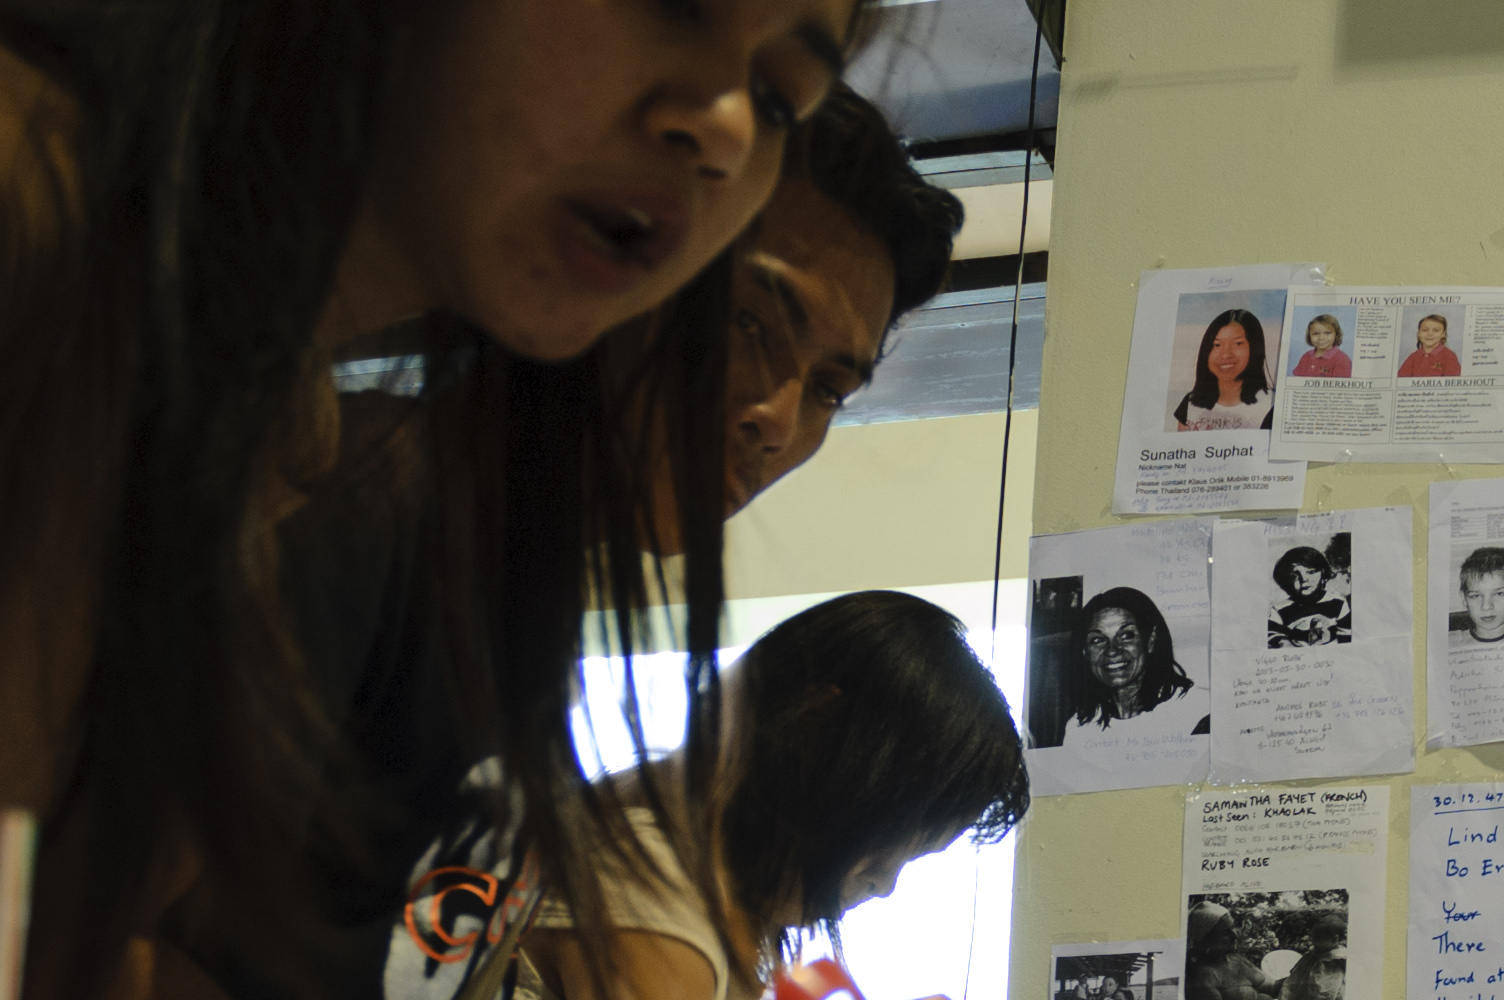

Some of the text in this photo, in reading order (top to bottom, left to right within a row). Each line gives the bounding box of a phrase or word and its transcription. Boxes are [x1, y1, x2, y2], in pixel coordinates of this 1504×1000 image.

[1350, 296, 1461, 305] HAVE YOU SEEN ME?
[1303, 380, 1374, 389] JOB BERKHOUT
[1412, 379, 1497, 388] MARIA BERKHOUT
[1140, 445, 1254, 461] Sunatha Suphat
[1203, 794, 1271, 813] SAMANTHA
[1279, 792, 1316, 805] FAYET
[1264, 807, 1317, 819] KHAOLAK
[1448, 825, 1499, 846] Lind
[1201, 857, 1271, 872] RUBY ROSE
[1446, 859, 1469, 878] Bo
[1432, 931, 1486, 954] There
